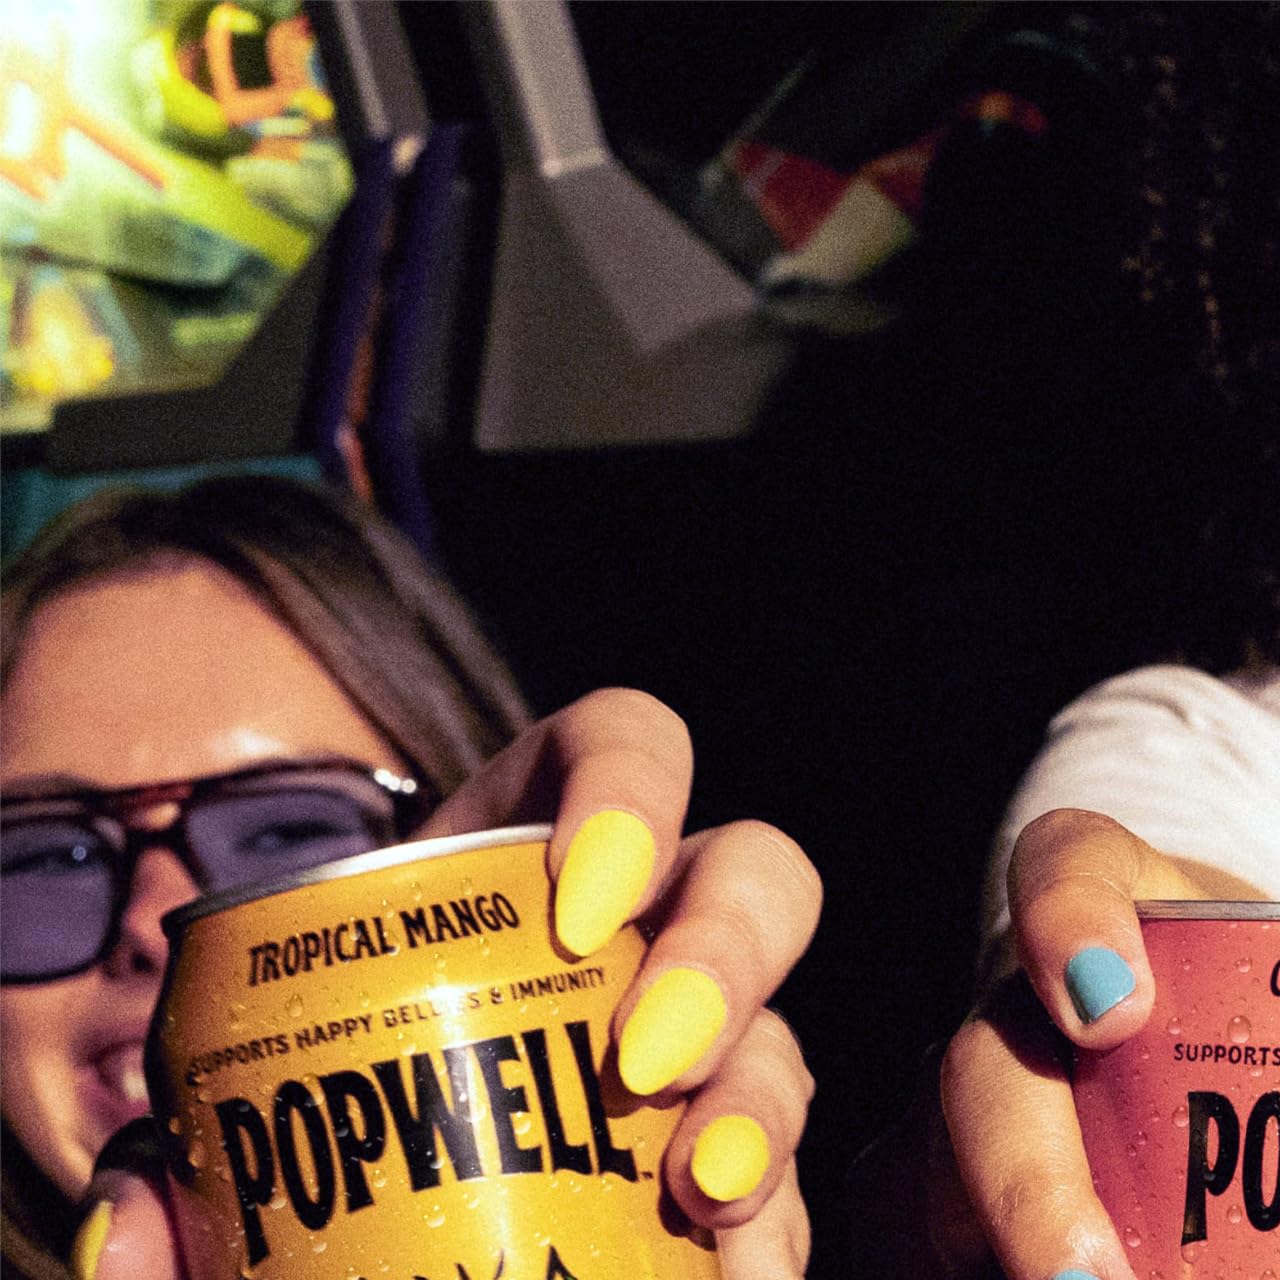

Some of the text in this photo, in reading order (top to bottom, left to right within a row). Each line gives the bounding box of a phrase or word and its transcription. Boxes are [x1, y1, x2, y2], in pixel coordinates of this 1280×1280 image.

[247, 891, 521, 987] TROPICAL MANGO
[294, 1013, 373, 1049] HAPPY
[384, 992, 481, 1028] BELLS
[489, 986, 503, 1005] &
[510, 966, 606, 1000] IMMUNITY
[214, 1020, 639, 1266] POPWELL
